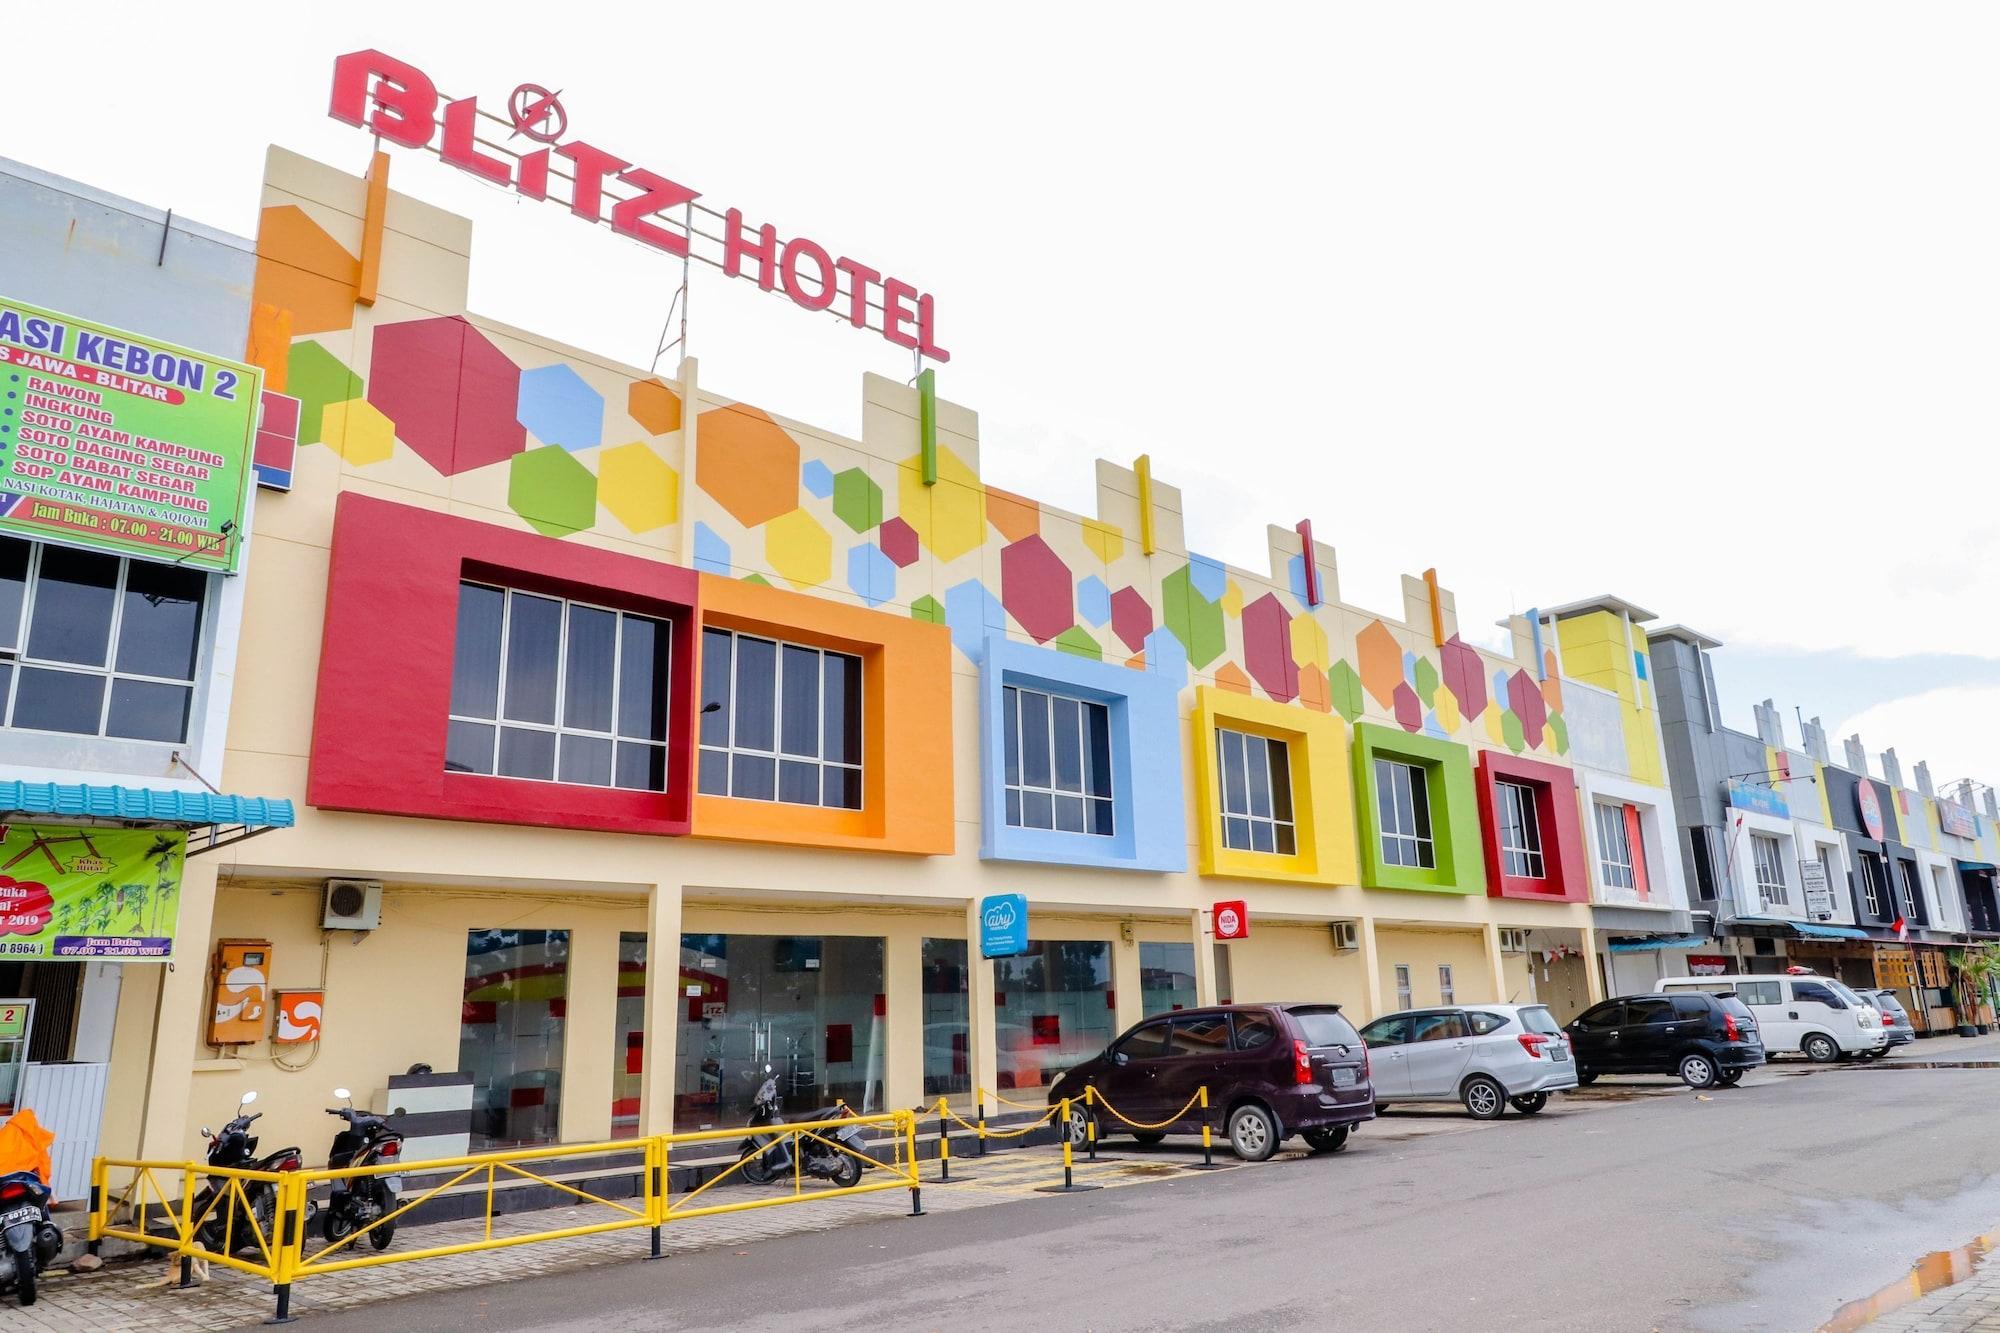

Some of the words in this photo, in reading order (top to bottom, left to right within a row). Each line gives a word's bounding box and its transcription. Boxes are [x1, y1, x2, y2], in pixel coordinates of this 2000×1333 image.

[723, 206, 950, 363] HOTEL
[16, 351, 77, 379] JAWA
[96, 370, 168, 401] BLITAR
[28, 376, 102, 405] RAWON
[76, 332, 204, 391] KEBON
[213, 370, 237, 400] 2
[25, 393, 113, 425] INGKUNG
[19, 427, 70, 448] SOTO
[75, 439, 146, 466] DAGING
[151, 457, 209, 480] SEGAR
[22, 410, 72, 432] SOTO
[77, 423, 130, 445] AYAM
[135, 436, 224, 467] KAMPUNG
[13, 461, 54, 478] SOP
[58, 470, 113, 492] AYAM
[118, 482, 208, 512] KAMPUNG
[16, 444, 67, 465] SOTO
[72, 456, 132, 479] BABAT
[136, 470, 195, 493] SEGAR
[4, 478, 36, 492] NASI
[40, 485, 86, 504] KOTAK,
[91, 495, 145, 515] HAJATAN
[148, 507, 157, 518] &
[160, 510, 208, 528] AQIQAH
[32, 502, 60, 520] Jam
[64, 507, 98, 528] Buka
[111, 517, 147, 537] 07.00
[159, 526, 193, 547] 21.00
[197, 534, 220, 551] WIB
[8, 914, 39, 926] 2019
[86, 937, 110, 947] Jam
[111, 937, 142, 947] Buka
[988, 909, 1012, 930] airy
[1220, 915, 1236, 925] NIDA
[10, 942, 36, 955] 8964
[5, 1009, 15, 1022] 2
